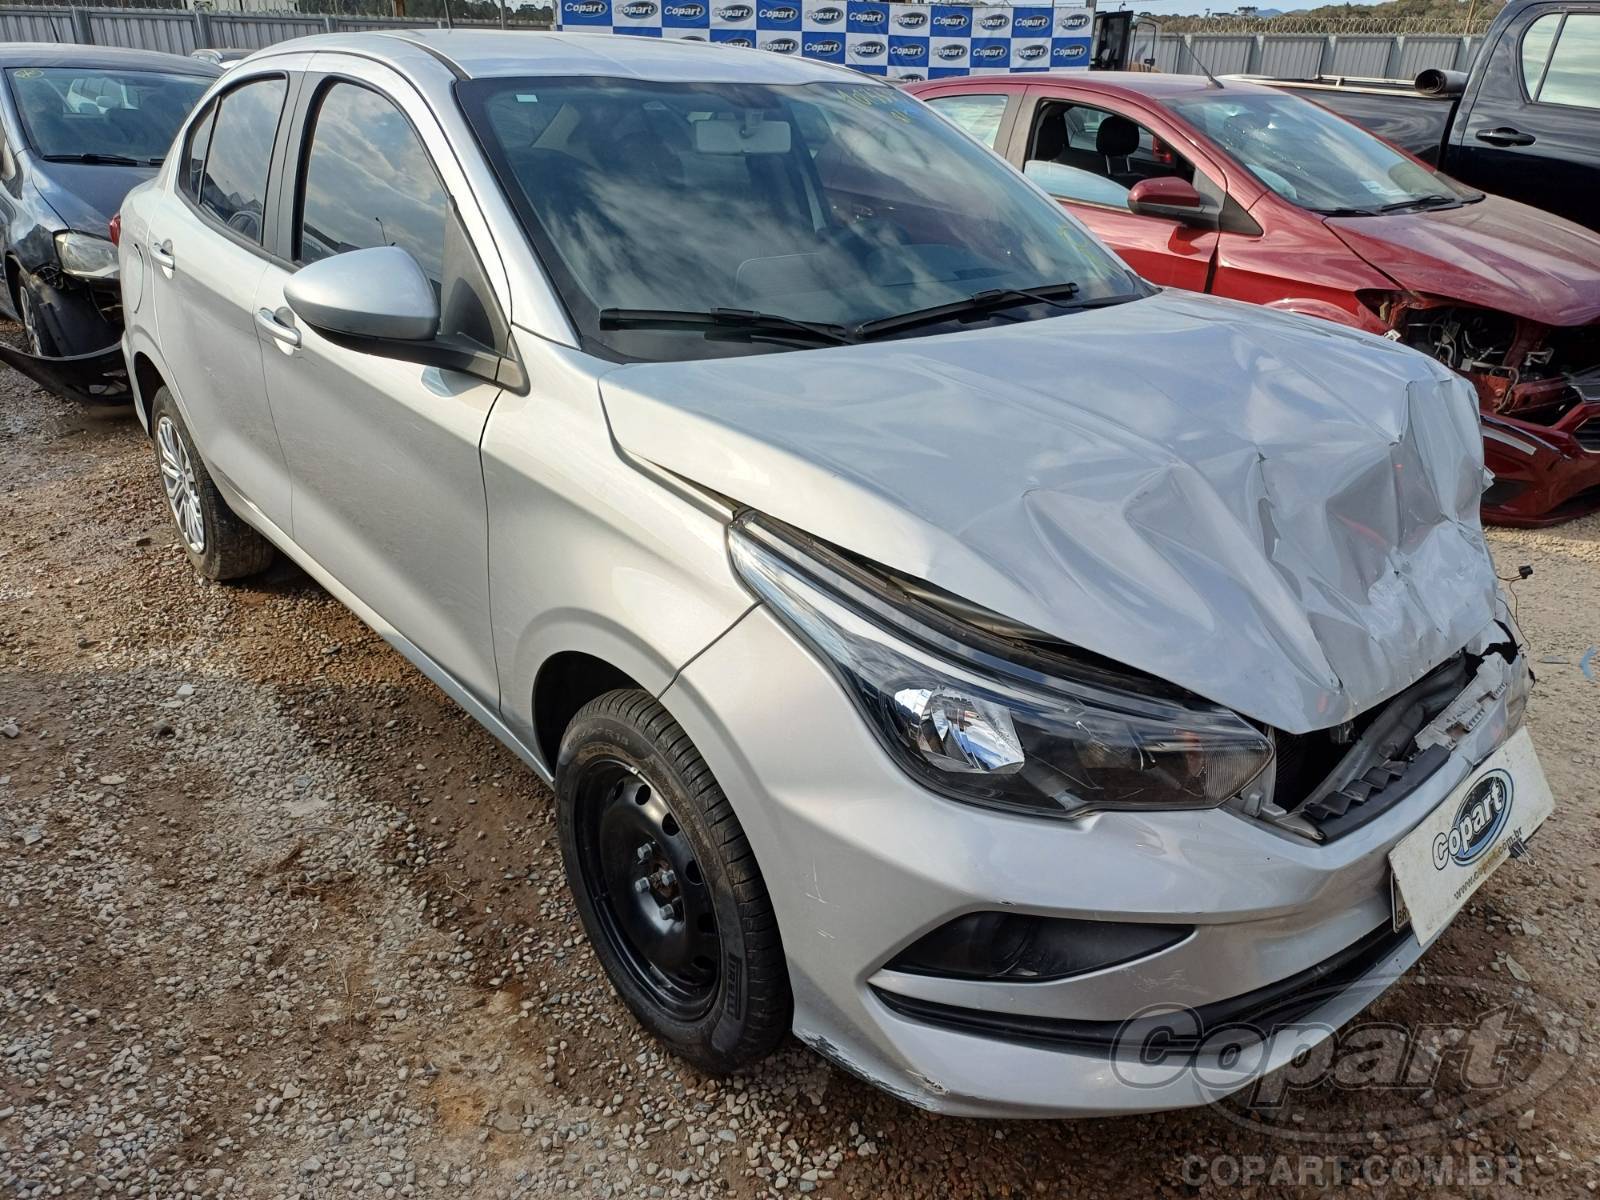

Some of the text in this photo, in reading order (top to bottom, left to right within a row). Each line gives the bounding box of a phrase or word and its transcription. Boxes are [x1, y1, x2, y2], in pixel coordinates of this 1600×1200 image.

[564, 2, 603, 14] Copart
[664, 5, 701, 16] Copart
[758, 8, 794, 20] Copart
[849, 12, 882, 23] Copart
[933, 16, 965, 27] Copart
[1014, 17, 1046, 28] Copart
[804, 42, 838, 53] Copart
[890, 46, 922, 56] Copart
[972, 47, 1004, 58] Copart
[1053, 46, 1084, 57] Copart
[1432, 777, 1504, 870] Copart
[1453, 826, 1523, 900] www.cop.com.br
